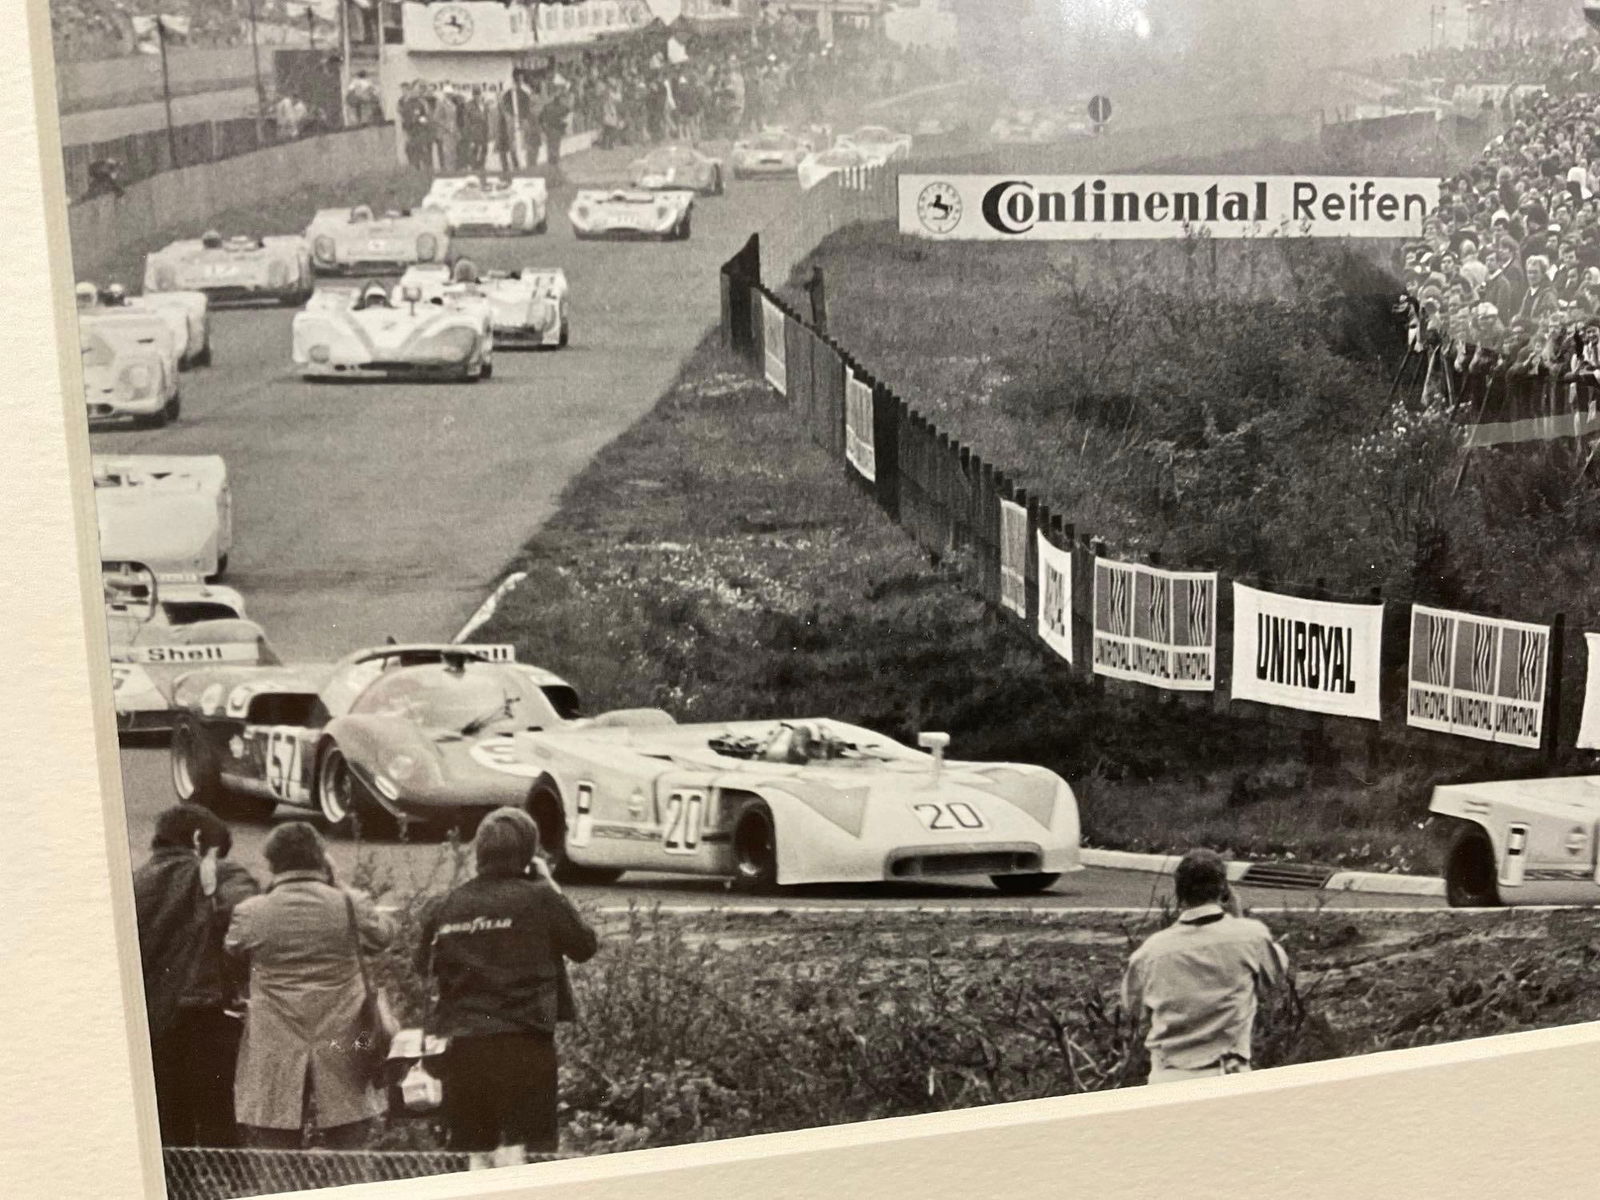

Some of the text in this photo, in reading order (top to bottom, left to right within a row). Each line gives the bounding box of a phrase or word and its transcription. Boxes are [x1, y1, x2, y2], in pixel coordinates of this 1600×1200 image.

[982, 179, 1268, 234] Continental
[1293, 181, 1427, 221] Reifen
[148, 647, 223, 661] Shell
[1256, 612, 1356, 694] UNIROYAL
[1410, 688, 1449, 722] UNIROYAL
[1452, 696, 1492, 731] UNIROYAL
[1496, 704, 1538, 738] UNIROYAL
[272, 732, 296, 799] 57
[666, 793, 702, 849] 20
[913, 802, 983, 830] 20
